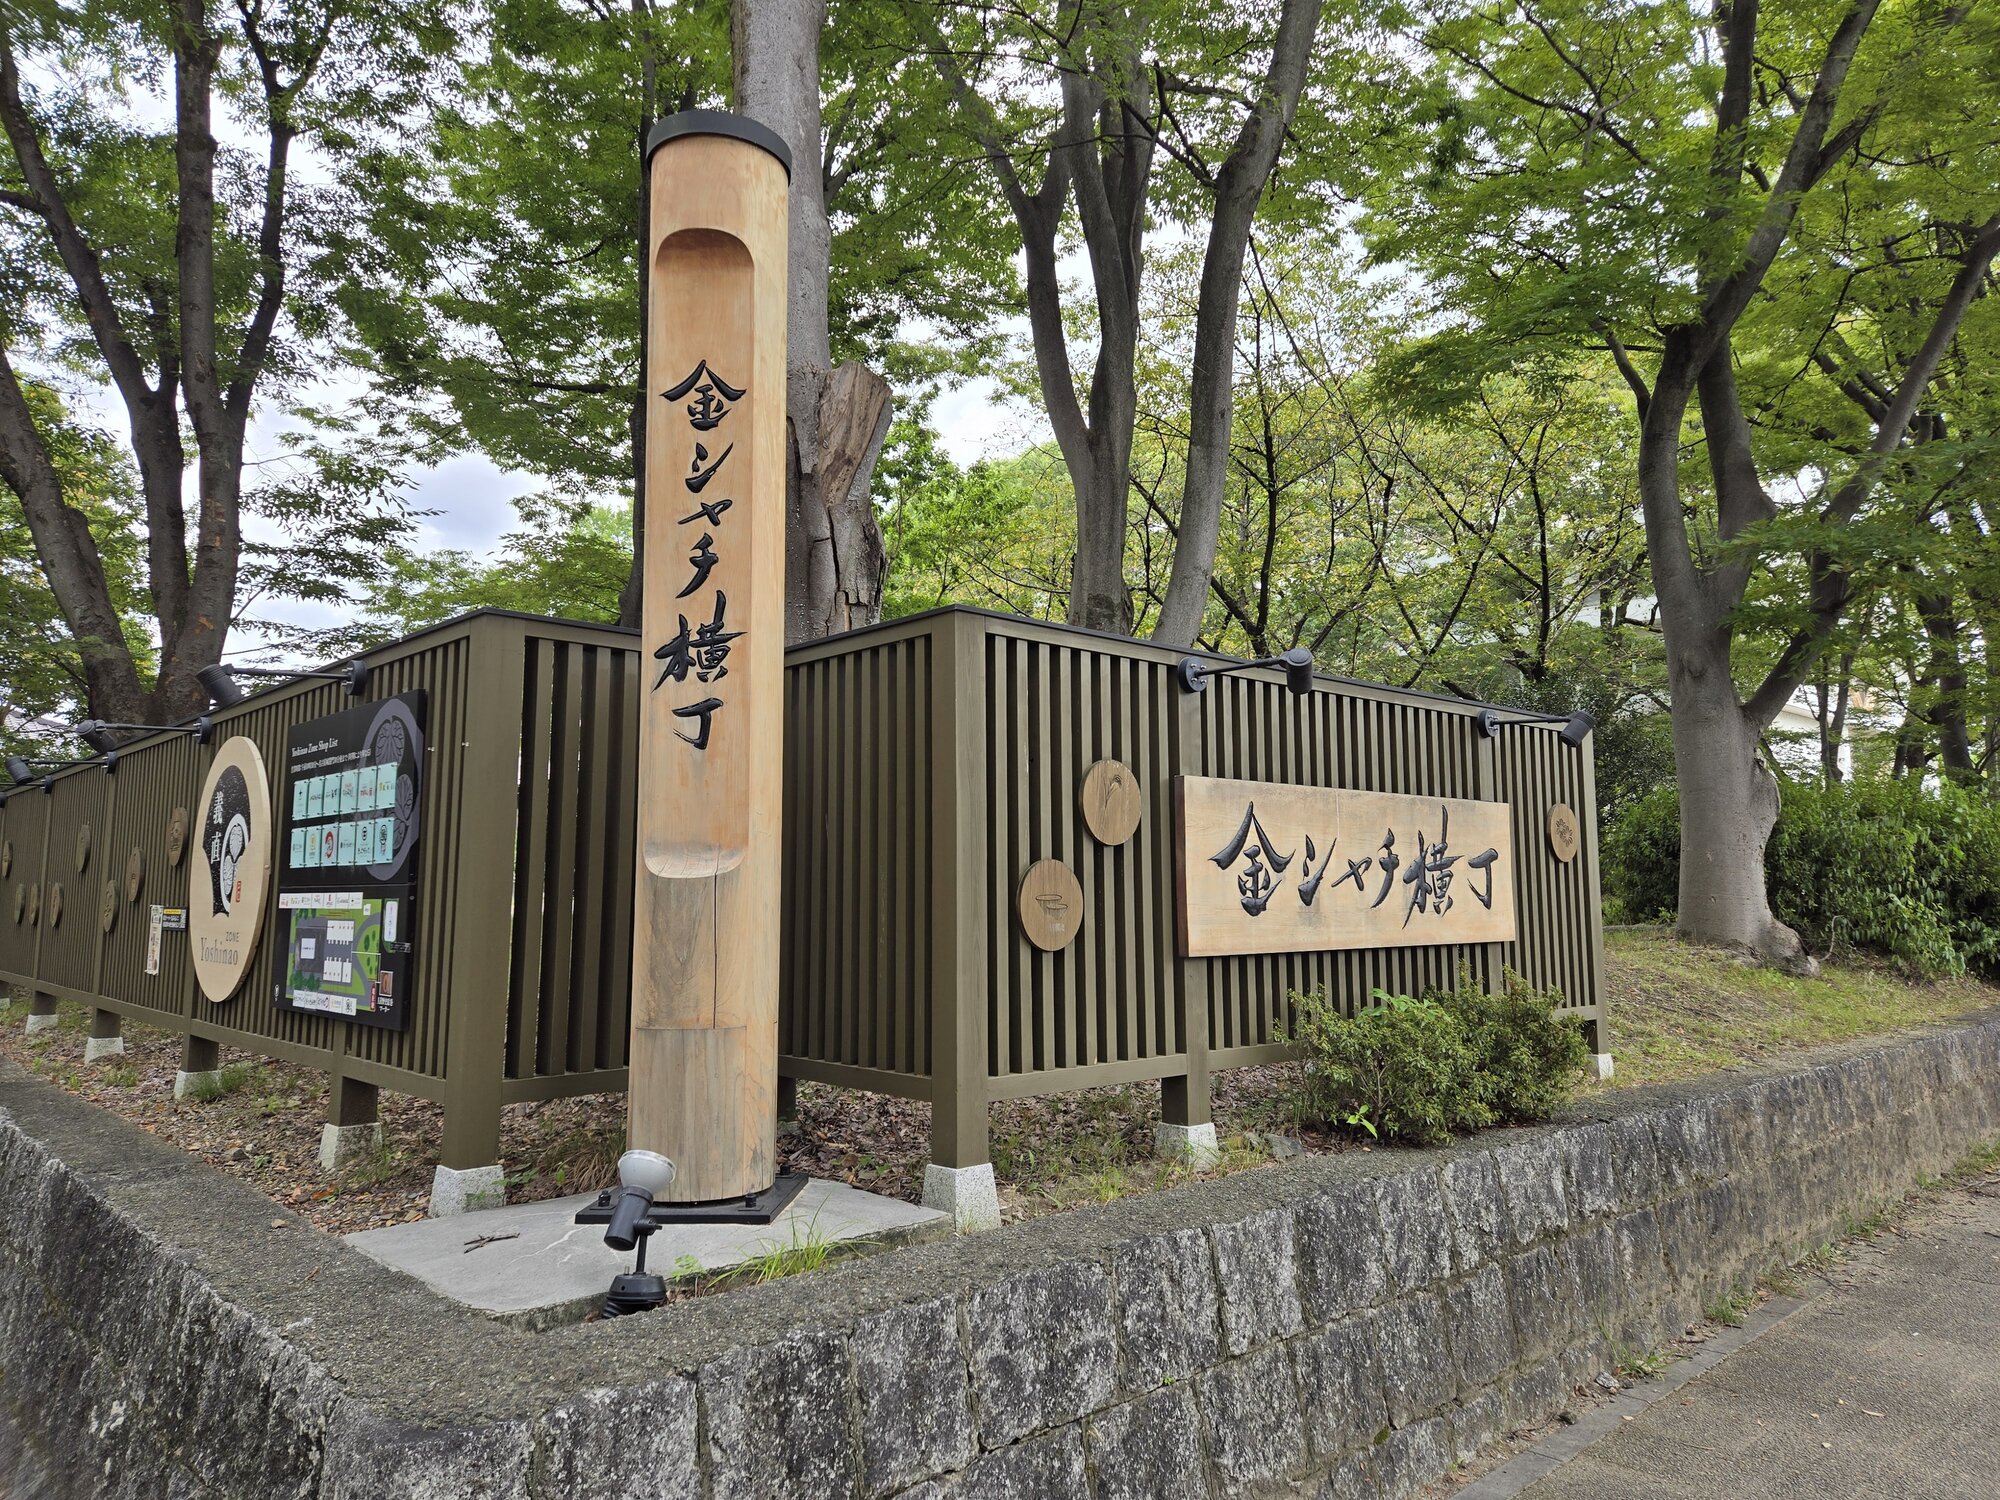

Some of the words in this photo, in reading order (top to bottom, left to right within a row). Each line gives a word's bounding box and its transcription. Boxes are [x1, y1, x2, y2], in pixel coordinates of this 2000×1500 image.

[651, 359, 747, 750] 金シャチ横丁
[1208, 801, 1498, 929] 金シャチ横丁
[200, 937, 239, 966] Yoshinao
[225, 931, 239, 942] ZONE
